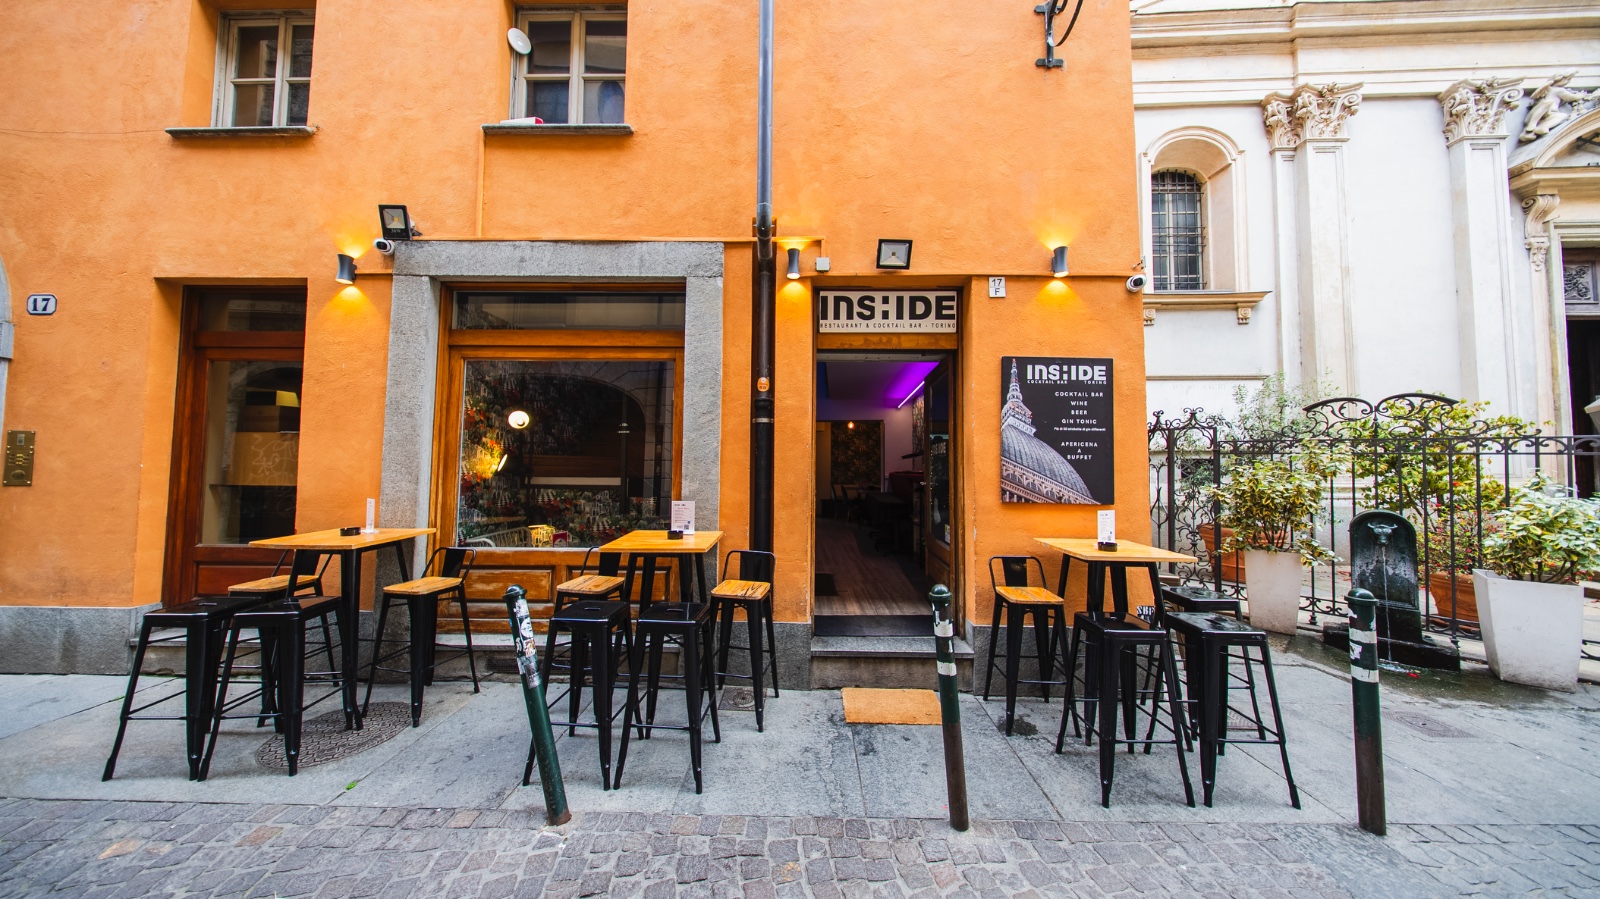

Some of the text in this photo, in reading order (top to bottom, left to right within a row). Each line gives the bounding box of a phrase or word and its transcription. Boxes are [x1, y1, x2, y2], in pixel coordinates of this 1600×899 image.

[991, 278, 1003, 287] 17
[994, 287, 1001, 296] F
[31, 297, 52, 312] 17
